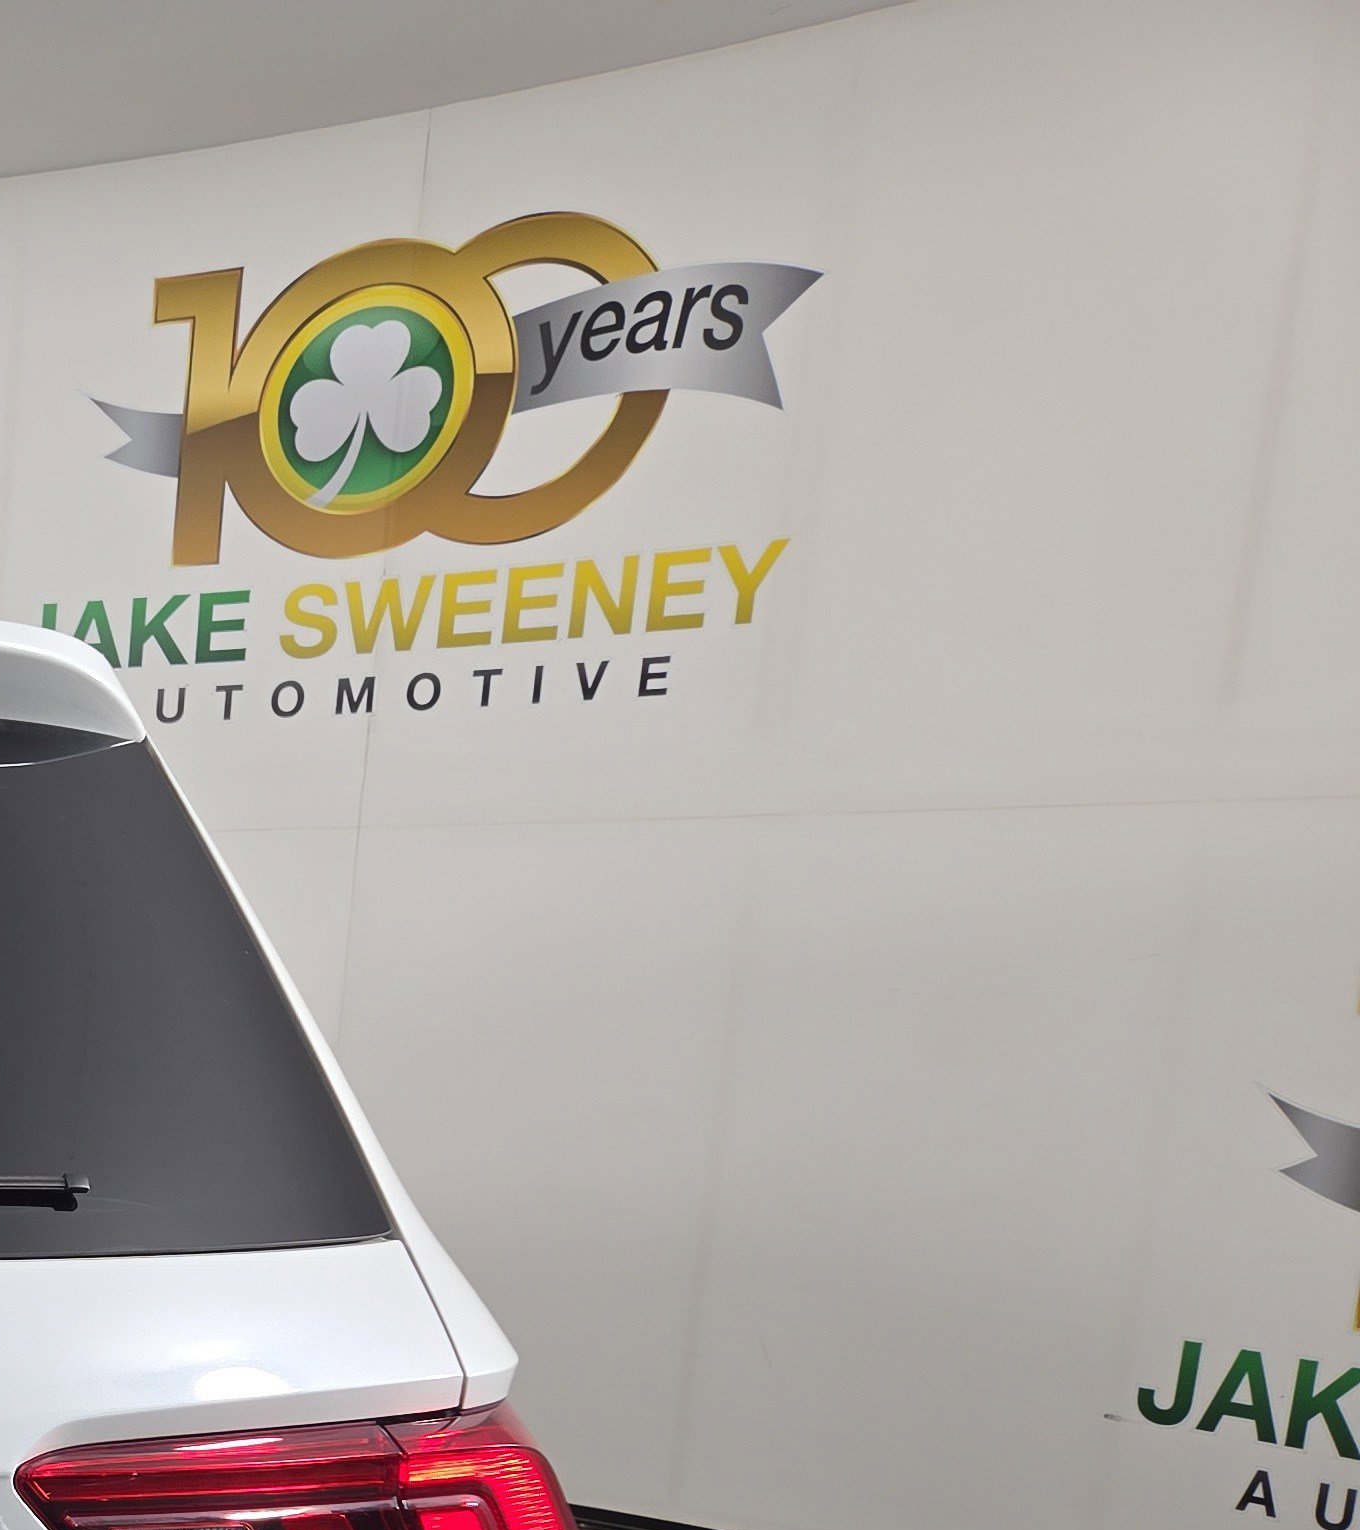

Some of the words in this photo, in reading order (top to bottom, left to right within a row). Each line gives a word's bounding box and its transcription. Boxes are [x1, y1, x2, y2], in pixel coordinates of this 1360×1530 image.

[530, 283, 748, 395] years
[280, 538, 791, 660] SWEENEY
[156, 655, 671, 724] UTOMOTIVE
